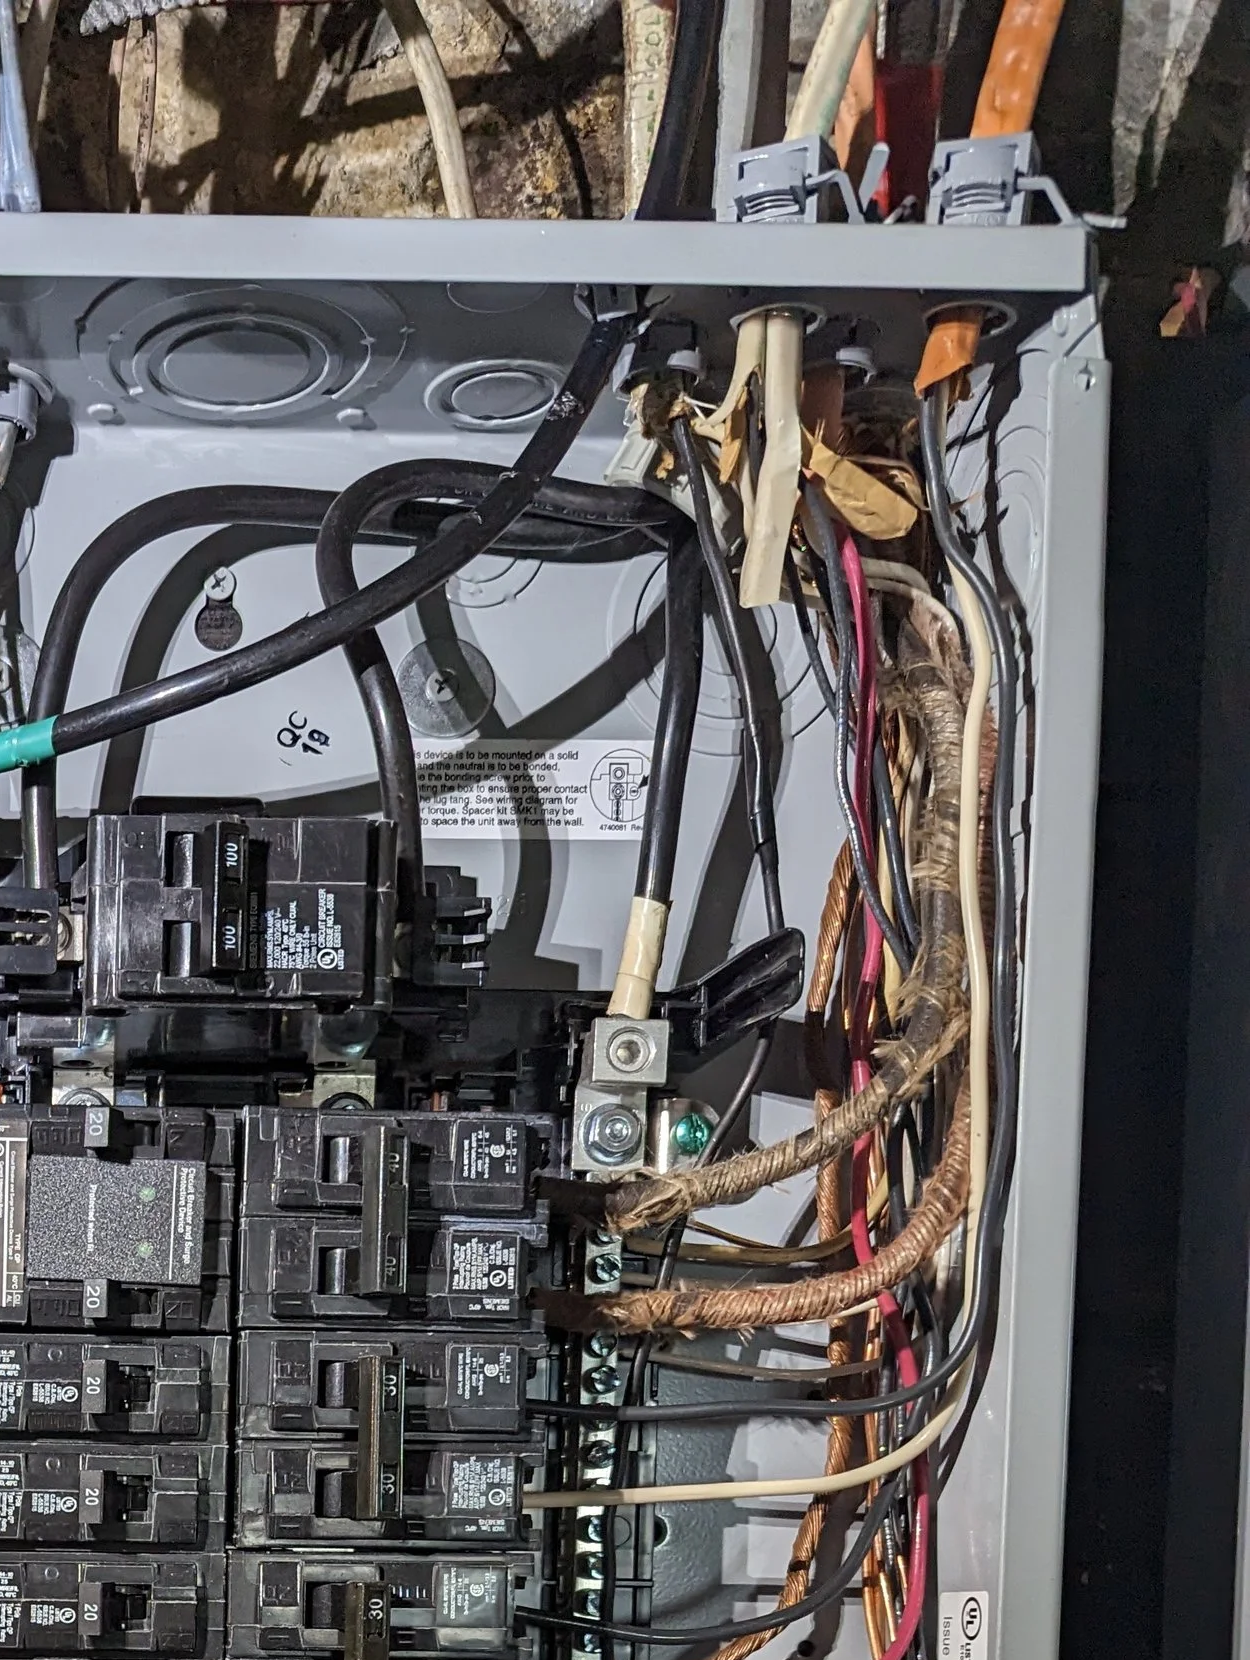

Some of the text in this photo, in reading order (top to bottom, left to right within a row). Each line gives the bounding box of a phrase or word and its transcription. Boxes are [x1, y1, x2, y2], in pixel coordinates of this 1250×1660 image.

[277, 710, 308, 748] QC
[424, 750, 579, 760] device mounted solid
[453, 761, 561, 772] neutral bonded,
[444, 773, 534, 784] bonding prior
[488, 785, 587, 796] ensure proper contact
[495, 796, 563, 807] wiring diagram
[427, 807, 459, 818] torque.
[461, 807, 495, 818] Spacer
[431, 818, 585, 829] space wall.
[224, 842, 239, 868] 100
[318, 889, 326, 948] CIRCUIT BREAKER
[222, 925, 236, 951] 100
[89, 1112, 103, 1137] 20
[178, 1207, 186, 1233] Device
[185, 1195, 195, 1224] Breaker
[86, 1285, 100, 1309] 20
[86, 1376, 101, 1394] 20
[383, 1374, 397, 1396] 30
[382, 1473, 395, 1494] 30
[85, 1488, 100, 1506] 20
[83, 1603, 98, 1621] 20
[368, 1598, 383, 1620] 30
[942, 1616, 954, 1655] Issue
